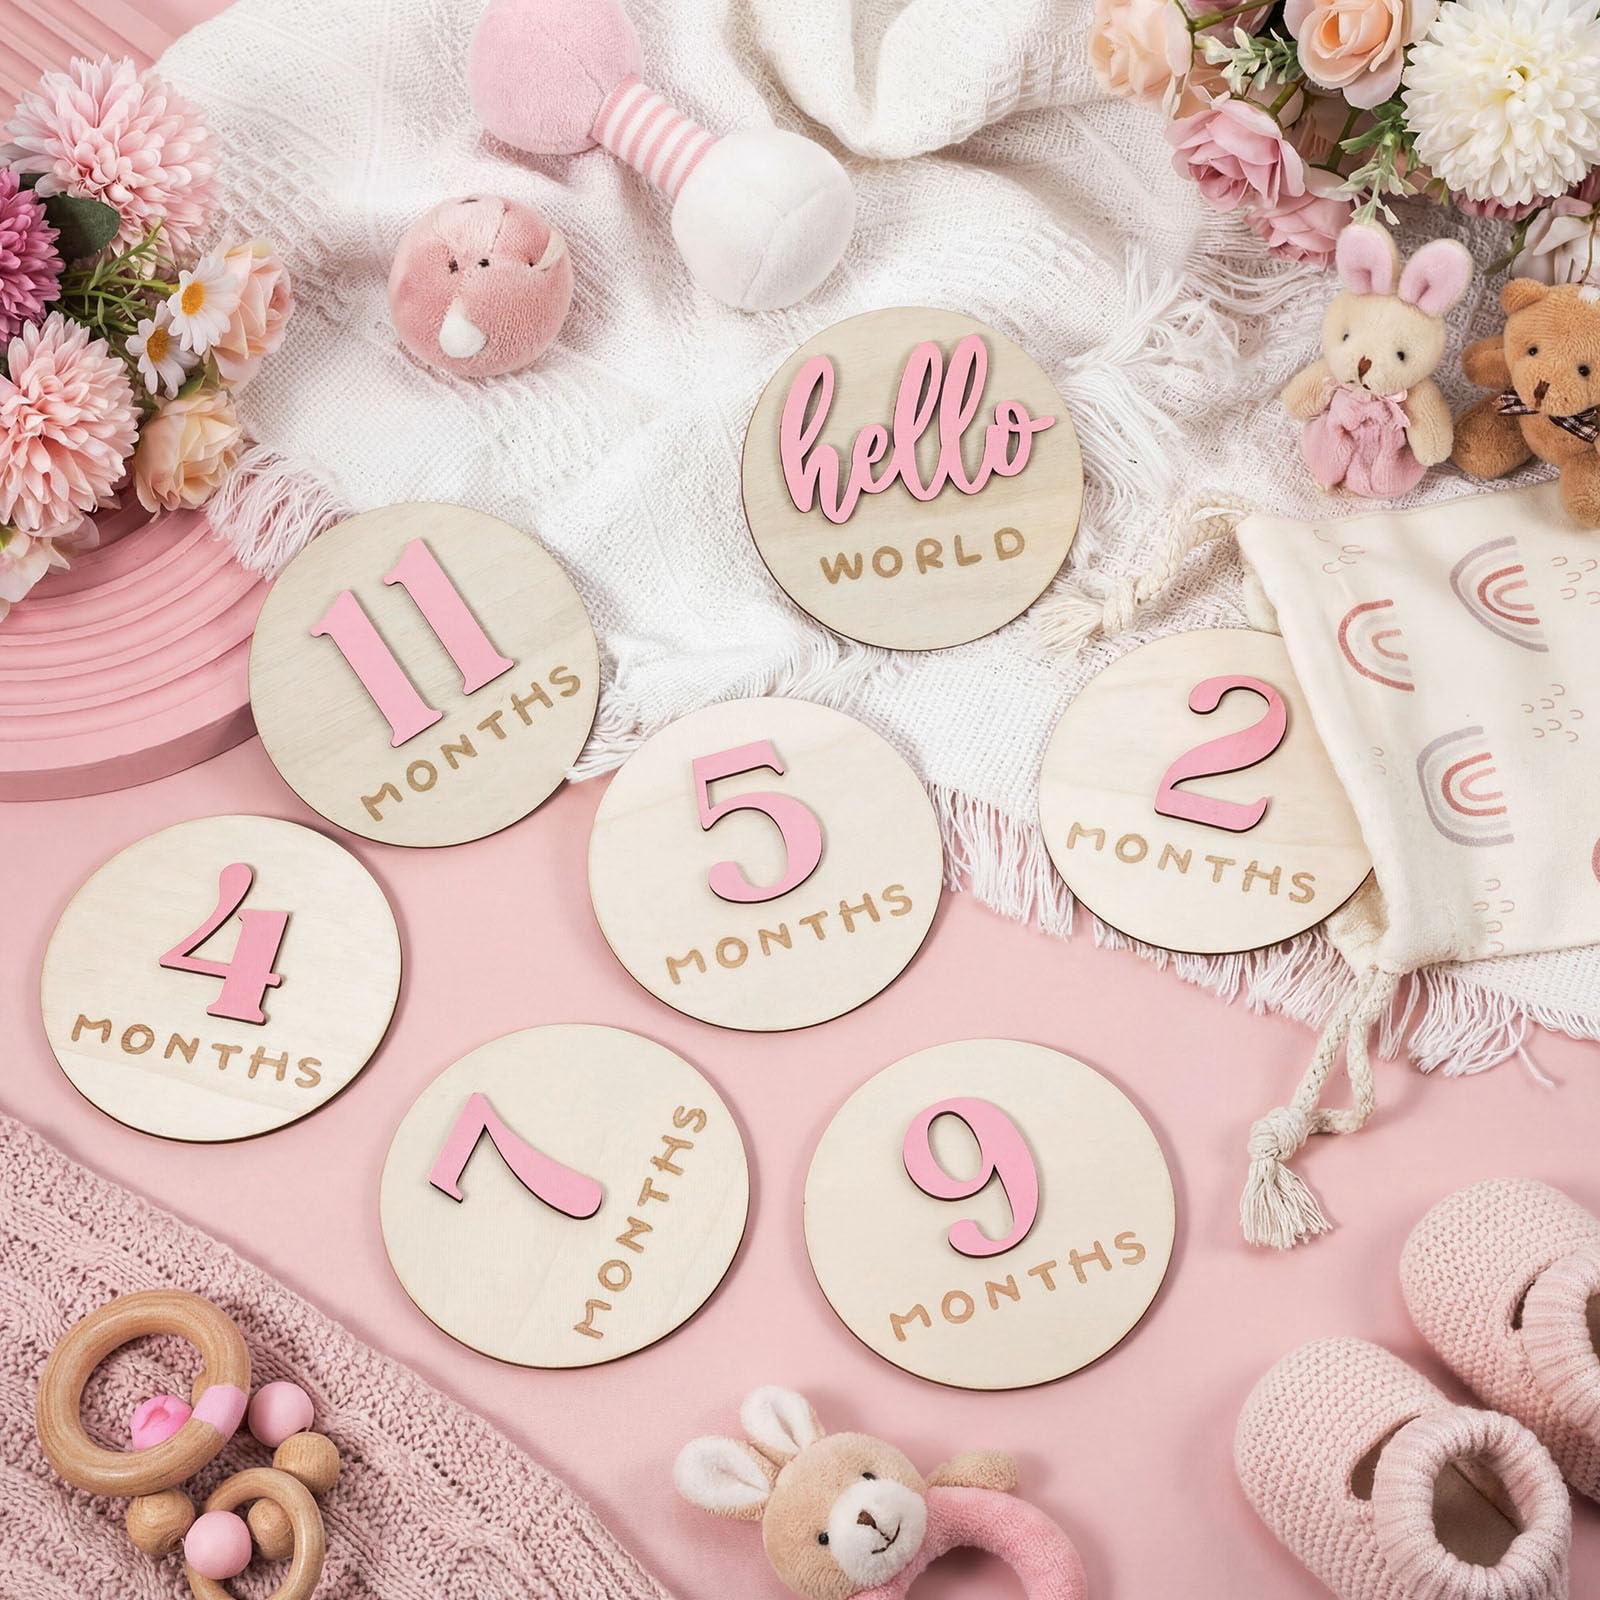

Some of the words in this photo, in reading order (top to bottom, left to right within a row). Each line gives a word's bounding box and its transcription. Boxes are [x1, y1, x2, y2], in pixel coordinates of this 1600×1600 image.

[780, 334, 1055, 525] hello
[822, 526, 1026, 585] WORLD
[311, 538, 515, 748] 11
[361, 665, 582, 821] MONTHS
[1155, 675, 1288, 832] 2
[691, 740, 824, 904] 5
[1066, 822, 1315, 904] MONTHS
[160, 863, 290, 1025] 4
[666, 884, 913, 985] MONTHS
[72, 1013, 322, 1088] MONTHS
[430, 1092, 603, 1220] 7
[574, 1105, 706, 1339] MONTHS
[903, 1097, 1039, 1257] 9
[891, 1231, 1147, 1341] MONTHS
